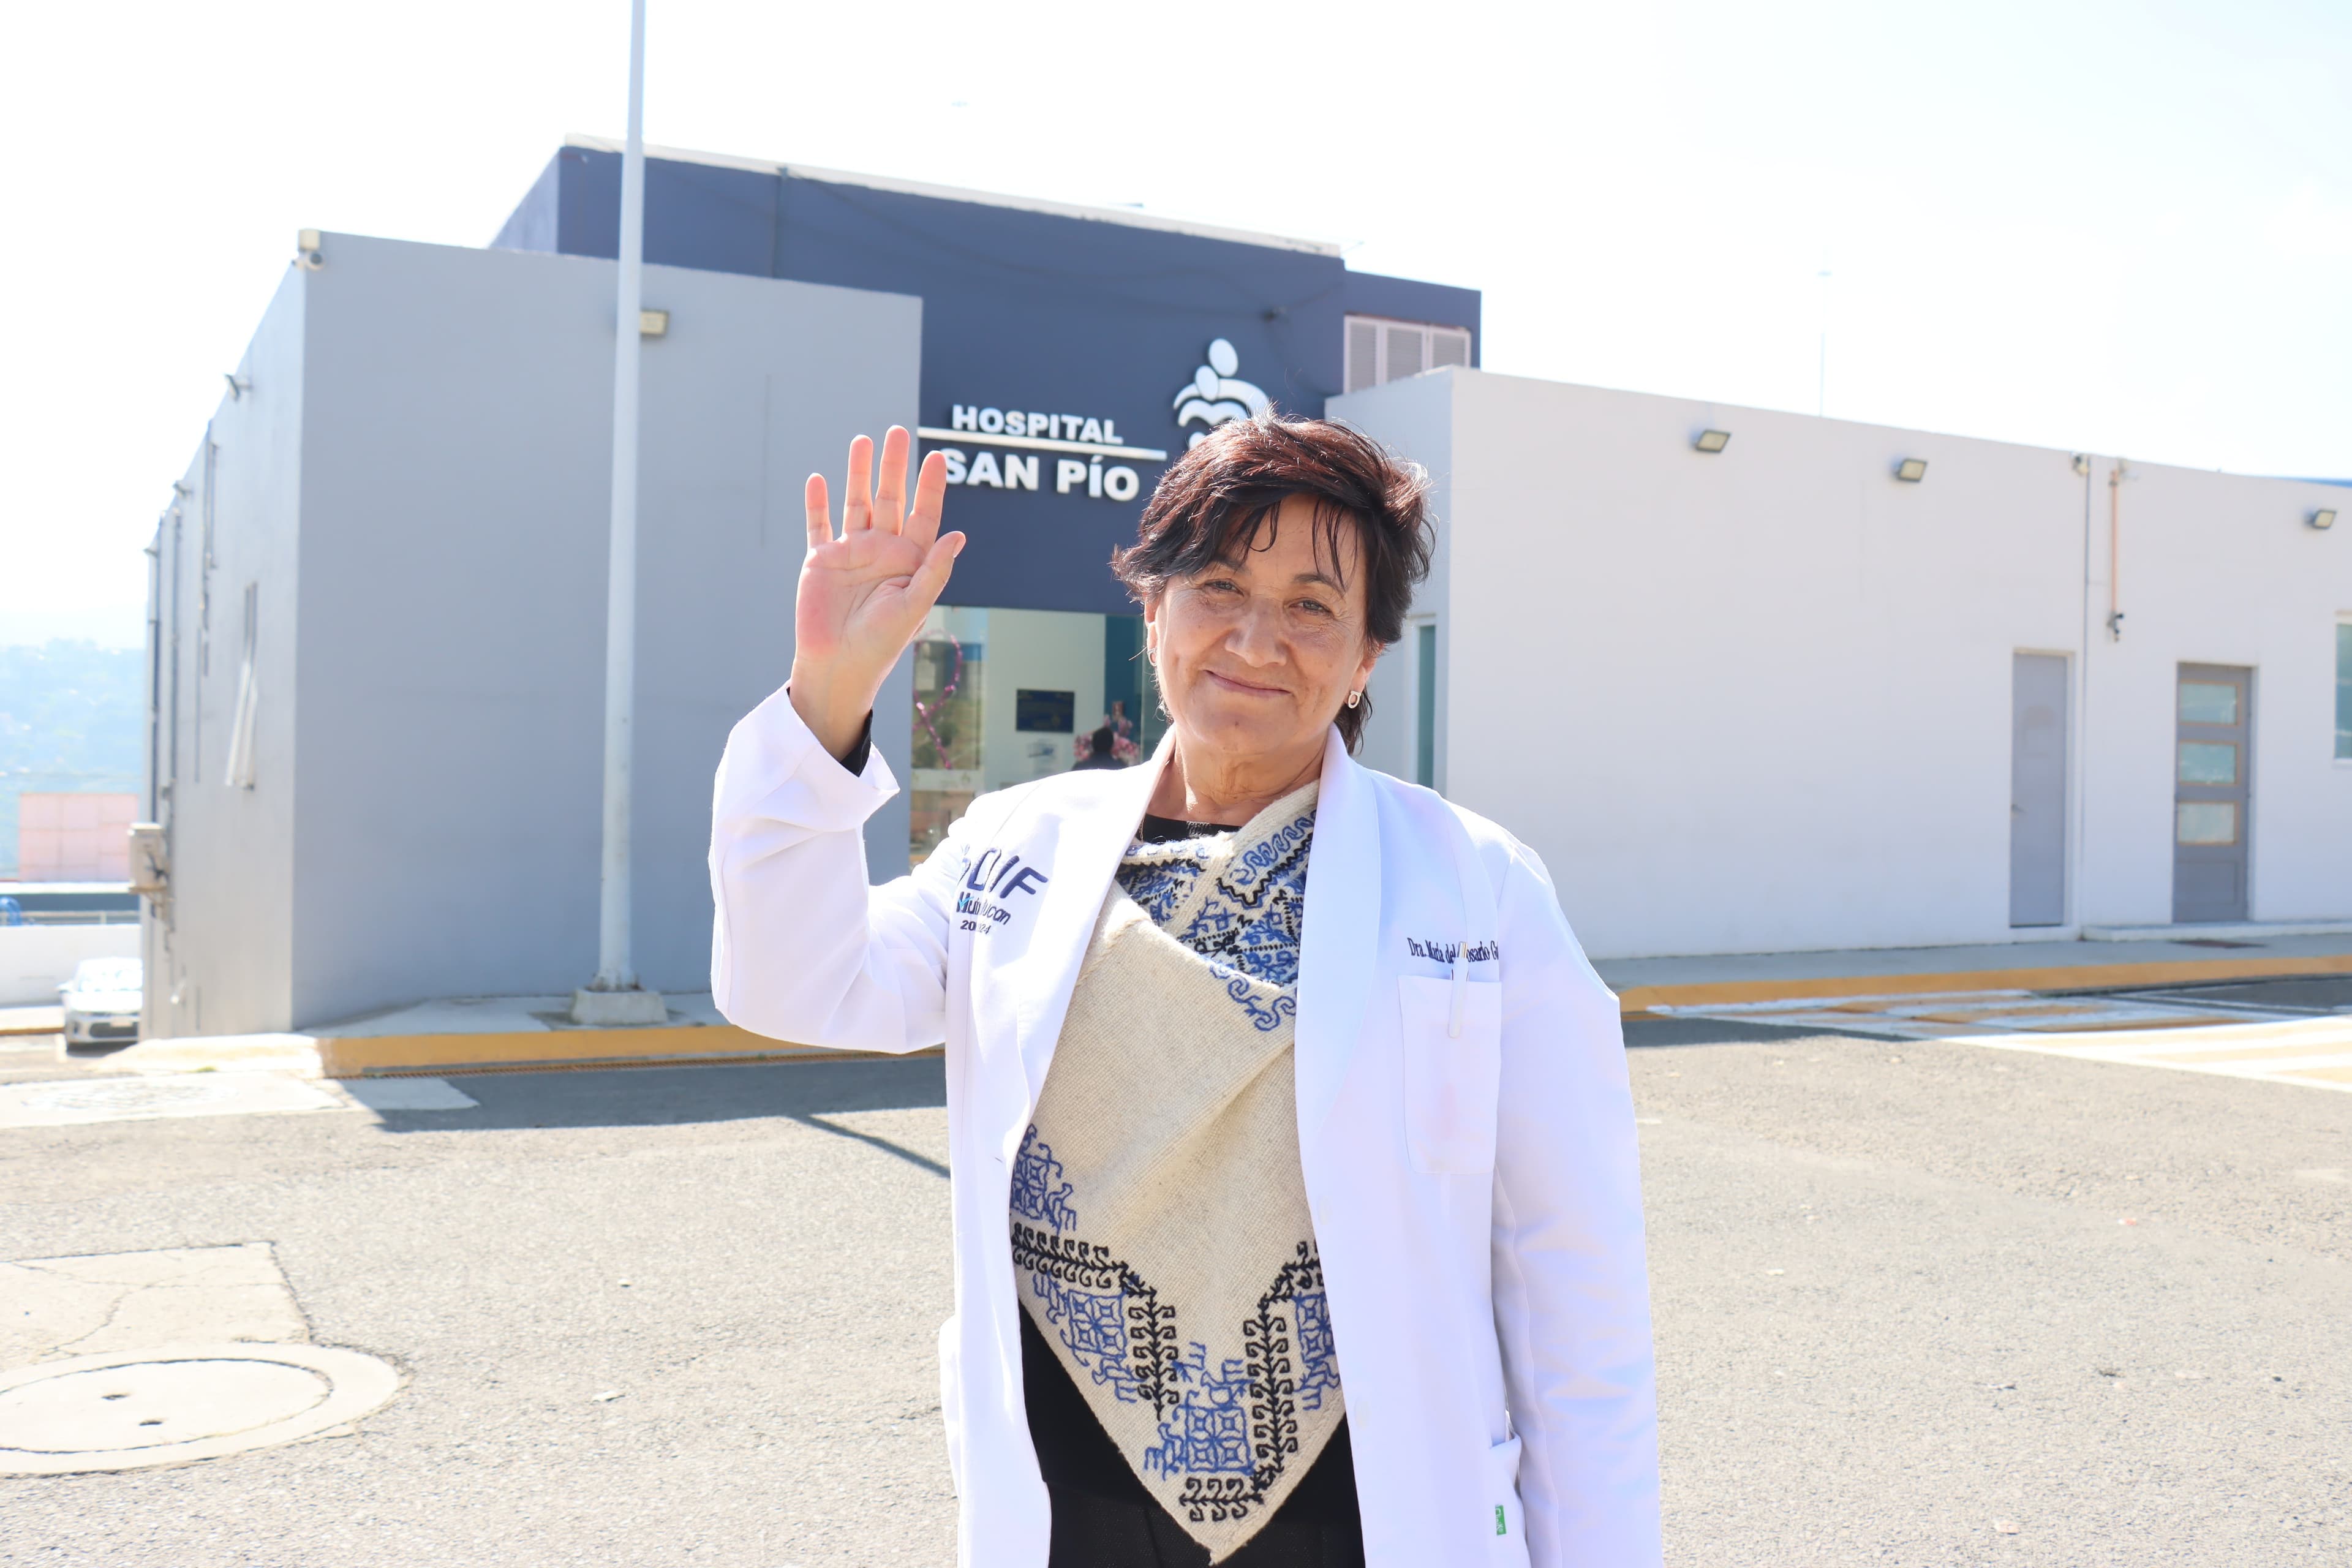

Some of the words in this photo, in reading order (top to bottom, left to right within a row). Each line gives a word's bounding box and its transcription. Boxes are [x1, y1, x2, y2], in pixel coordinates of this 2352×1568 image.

[952, 404, 1124, 445] HOSPITAL
[939, 448, 1039, 490] SAN
[1057, 454, 1140, 502] PÍO
[1406, 937, 1427, 957] Dra.
[1445, 943, 1457, 965] del
[1466, 940, 1490, 963] osario
